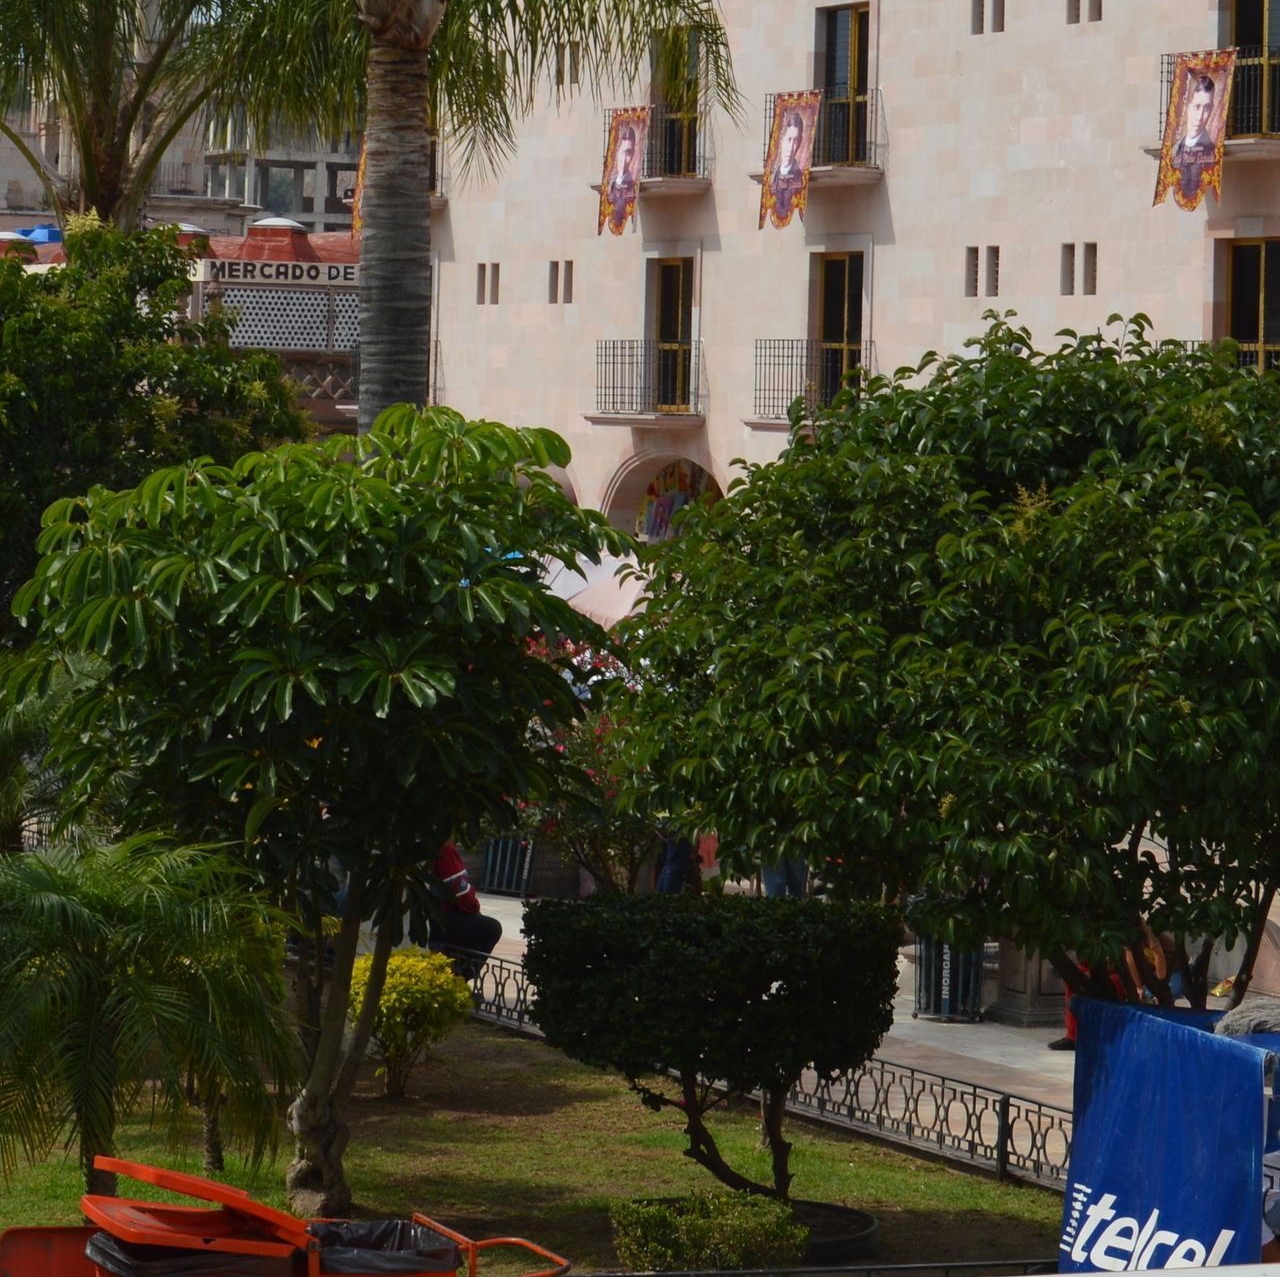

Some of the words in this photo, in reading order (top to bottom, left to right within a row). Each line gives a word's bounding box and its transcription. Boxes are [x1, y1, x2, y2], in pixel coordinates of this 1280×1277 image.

[210, 261, 320, 280] MERCADO
[327, 265, 355, 281] DE
[1071, 1193, 1235, 1271] telcel
